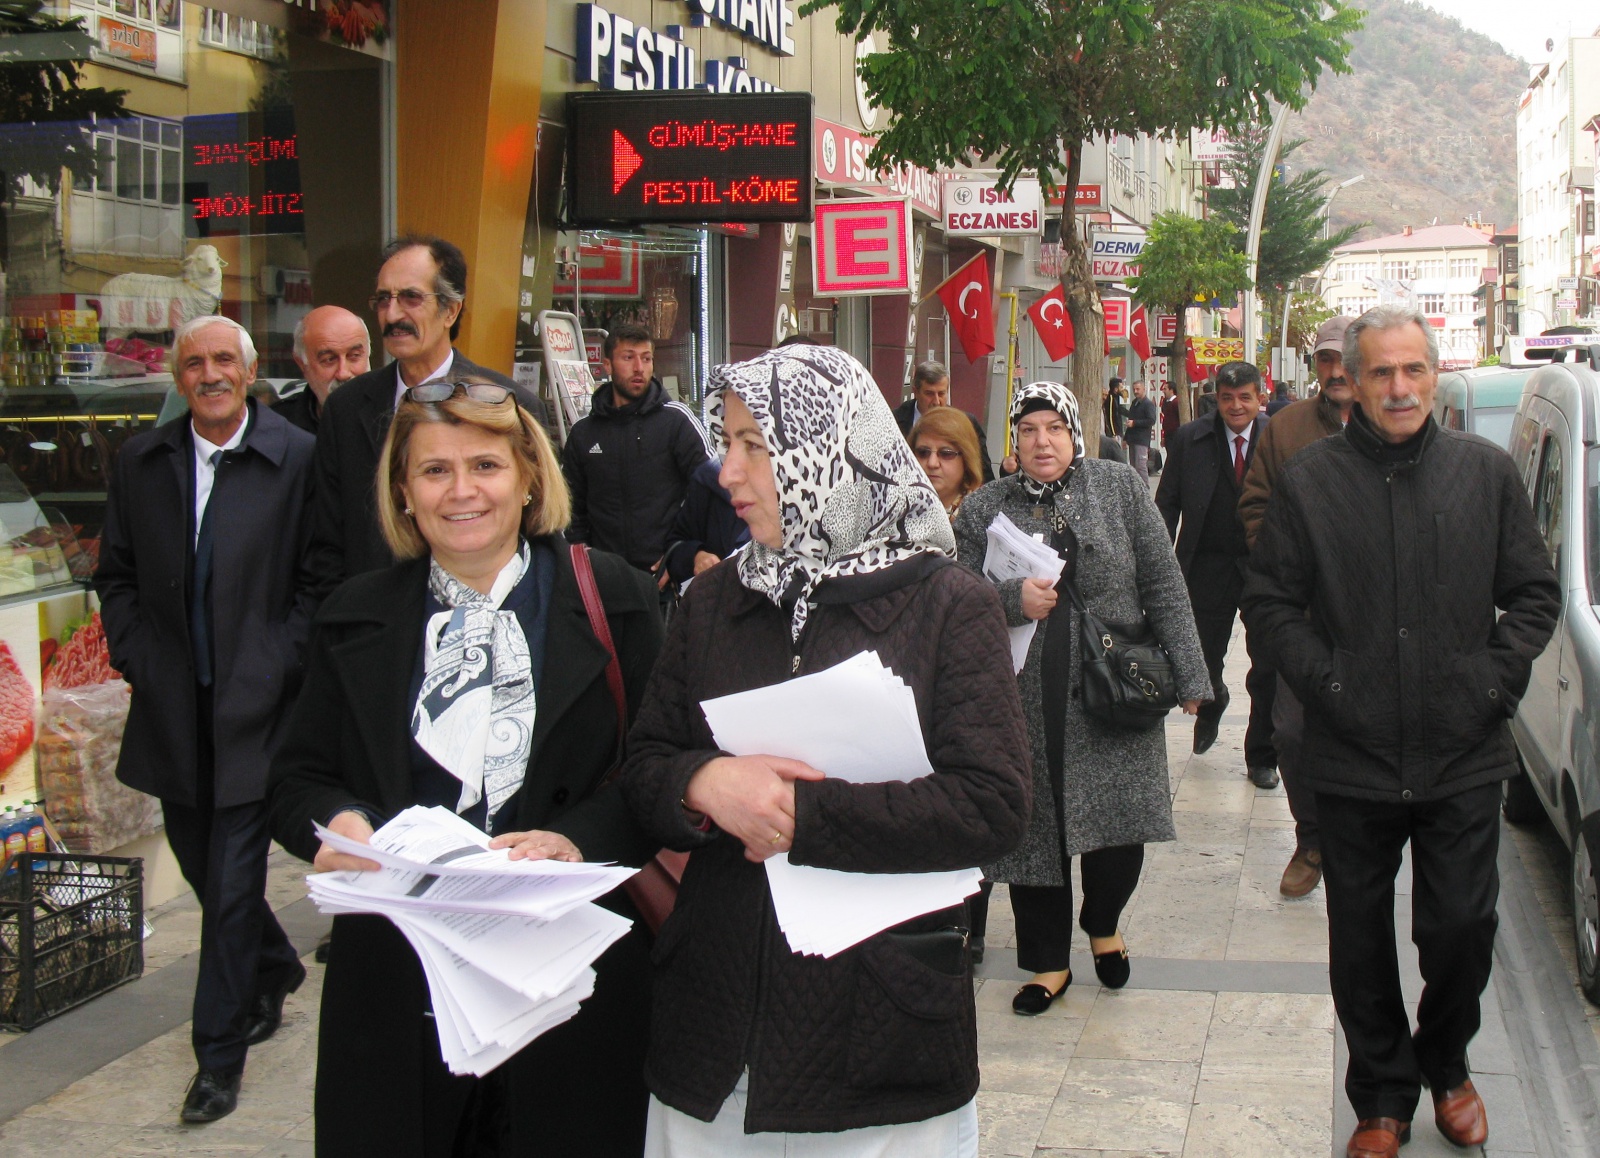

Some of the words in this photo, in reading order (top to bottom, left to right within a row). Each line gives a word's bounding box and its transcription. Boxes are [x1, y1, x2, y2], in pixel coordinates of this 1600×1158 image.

[648, 121, 797, 151] GÜMÜŞHANE
[643, 177, 799, 204] PESTİL-KÖME
[1086, 191, 1097, 199] 53
[949, 210, 1038, 230] ECZANESİ
[834, 216, 890, 277] E
[1093, 241, 1146, 255] DERM
